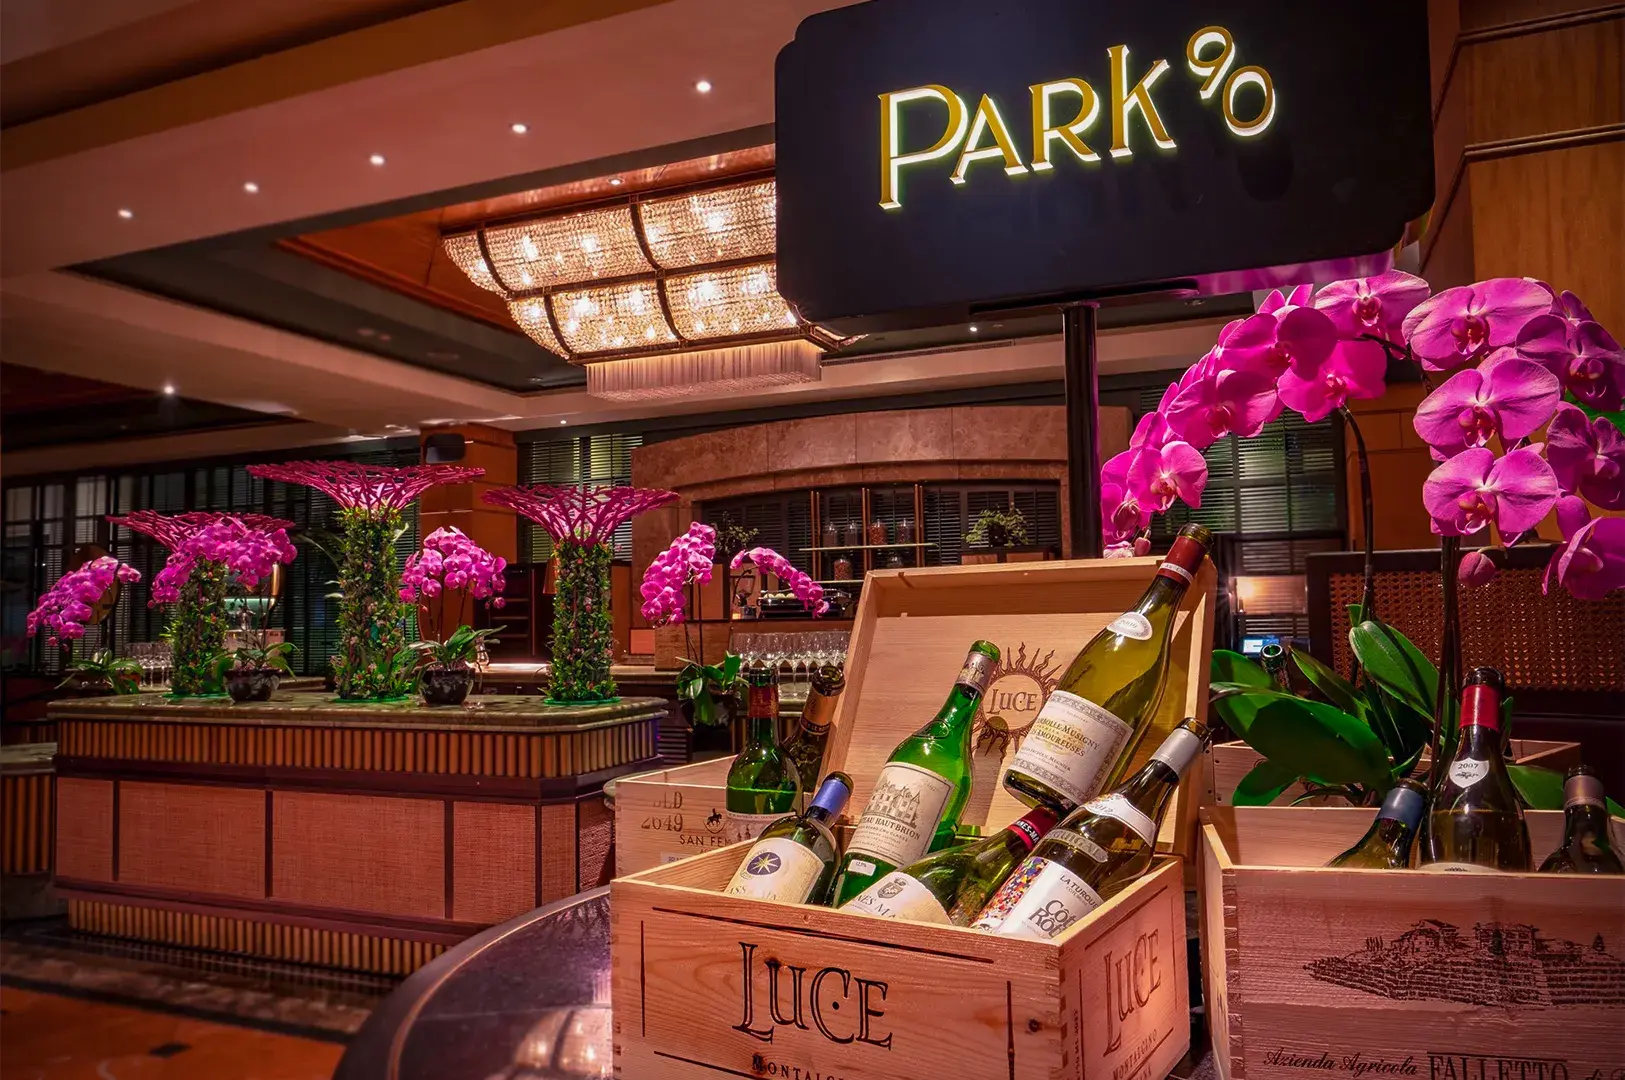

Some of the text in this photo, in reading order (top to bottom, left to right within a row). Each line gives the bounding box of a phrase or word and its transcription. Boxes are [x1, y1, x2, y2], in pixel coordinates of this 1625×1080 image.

[878, 25, 1276, 210] PARK 90
[985, 688, 1038, 715] LUCE
[679, 834, 704, 846] SAN
[1060, 875, 1071, 885] LA
[732, 941, 893, 1051] LUCE
[1103, 928, 1161, 1057] LUCE
[1263, 1047, 1336, 1070] Azienda
[1339, 1052, 1418, 1078] Agricola
[1429, 1055, 1568, 1080] FALLETTO
